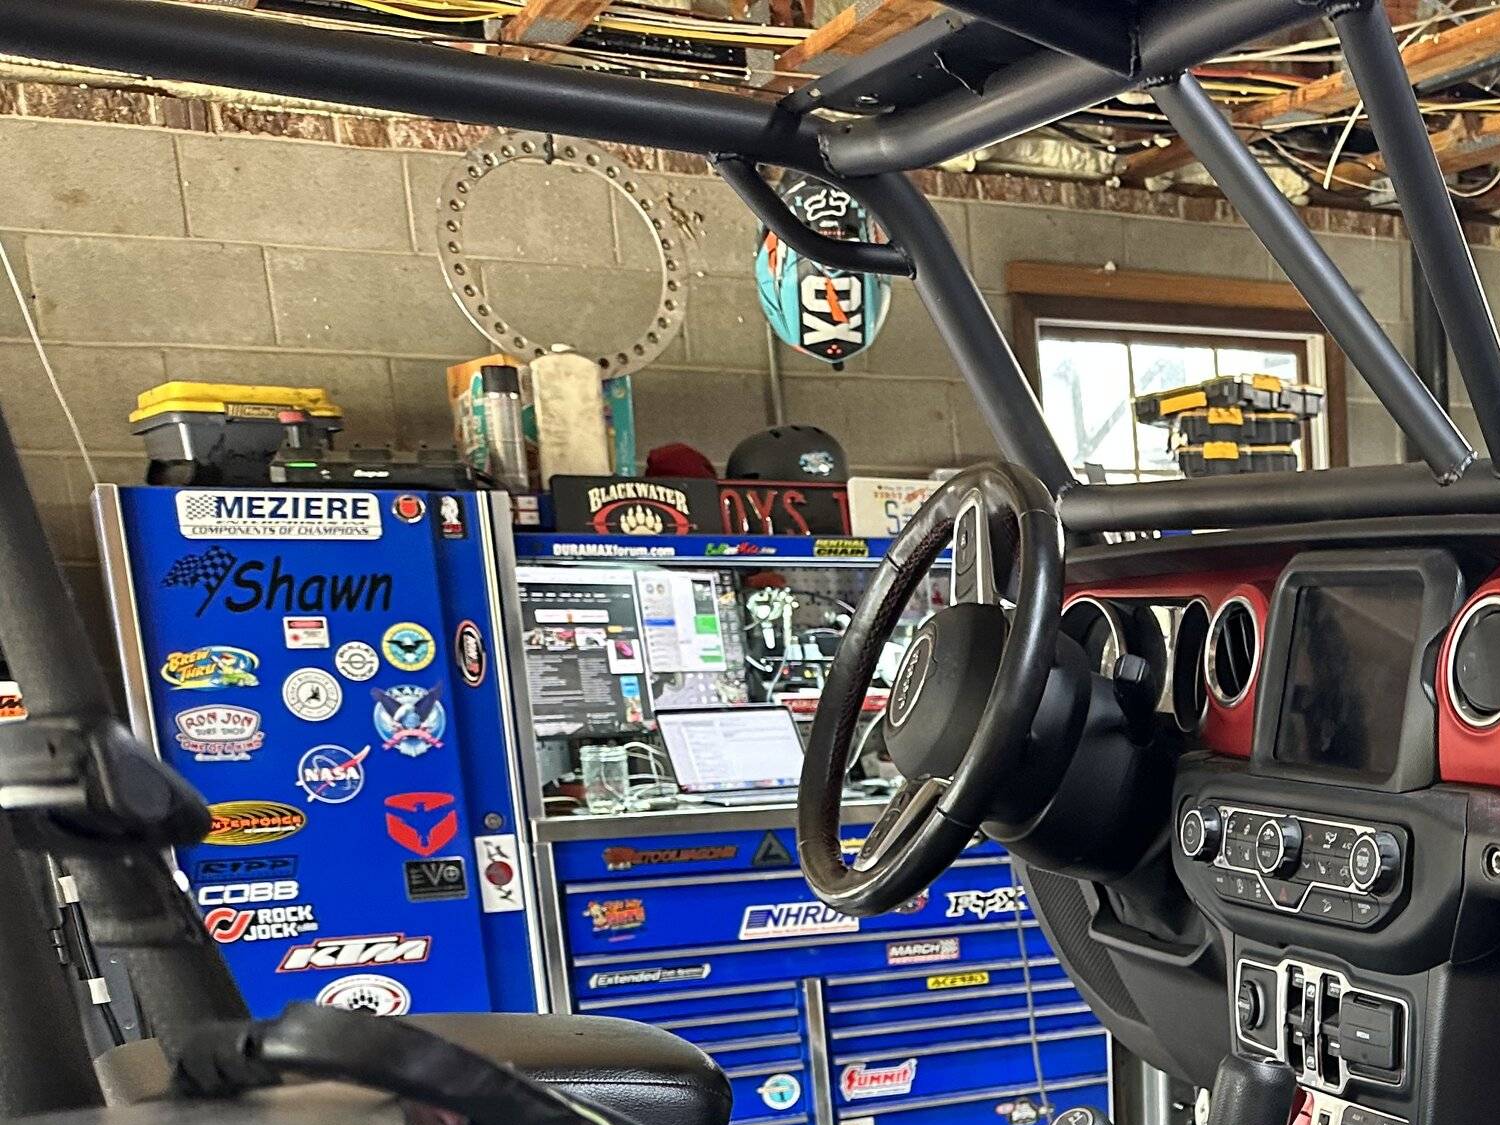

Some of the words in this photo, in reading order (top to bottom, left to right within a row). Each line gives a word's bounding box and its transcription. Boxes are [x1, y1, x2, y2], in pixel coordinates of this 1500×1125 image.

[216, 496, 370, 520] MEZIERE
[587, 482, 691, 516] BLACKWATER
[191, 525, 276, 536] COMPONENTS
[278, 525, 294, 536] OF
[297, 525, 369, 536] CHAMPIONS
[553, 543, 676, 557] DURAMAXforum.com
[816, 548, 866, 557] CHAIN
[223, 556, 393, 614] Shawn
[185, 712, 218, 728] RON
[220, 712, 254, 727] JON
[303, 766, 361, 783] NASA
[209, 814, 301, 835] NTERFORCE
[198, 880, 299, 906] COBB
[257, 905, 314, 924] ROCK
[243, 922, 299, 941] JOCK
[284, 936, 429, 970] KTM
[889, 943, 940, 957] MARCH
[597, 970, 661, 986] Extended
